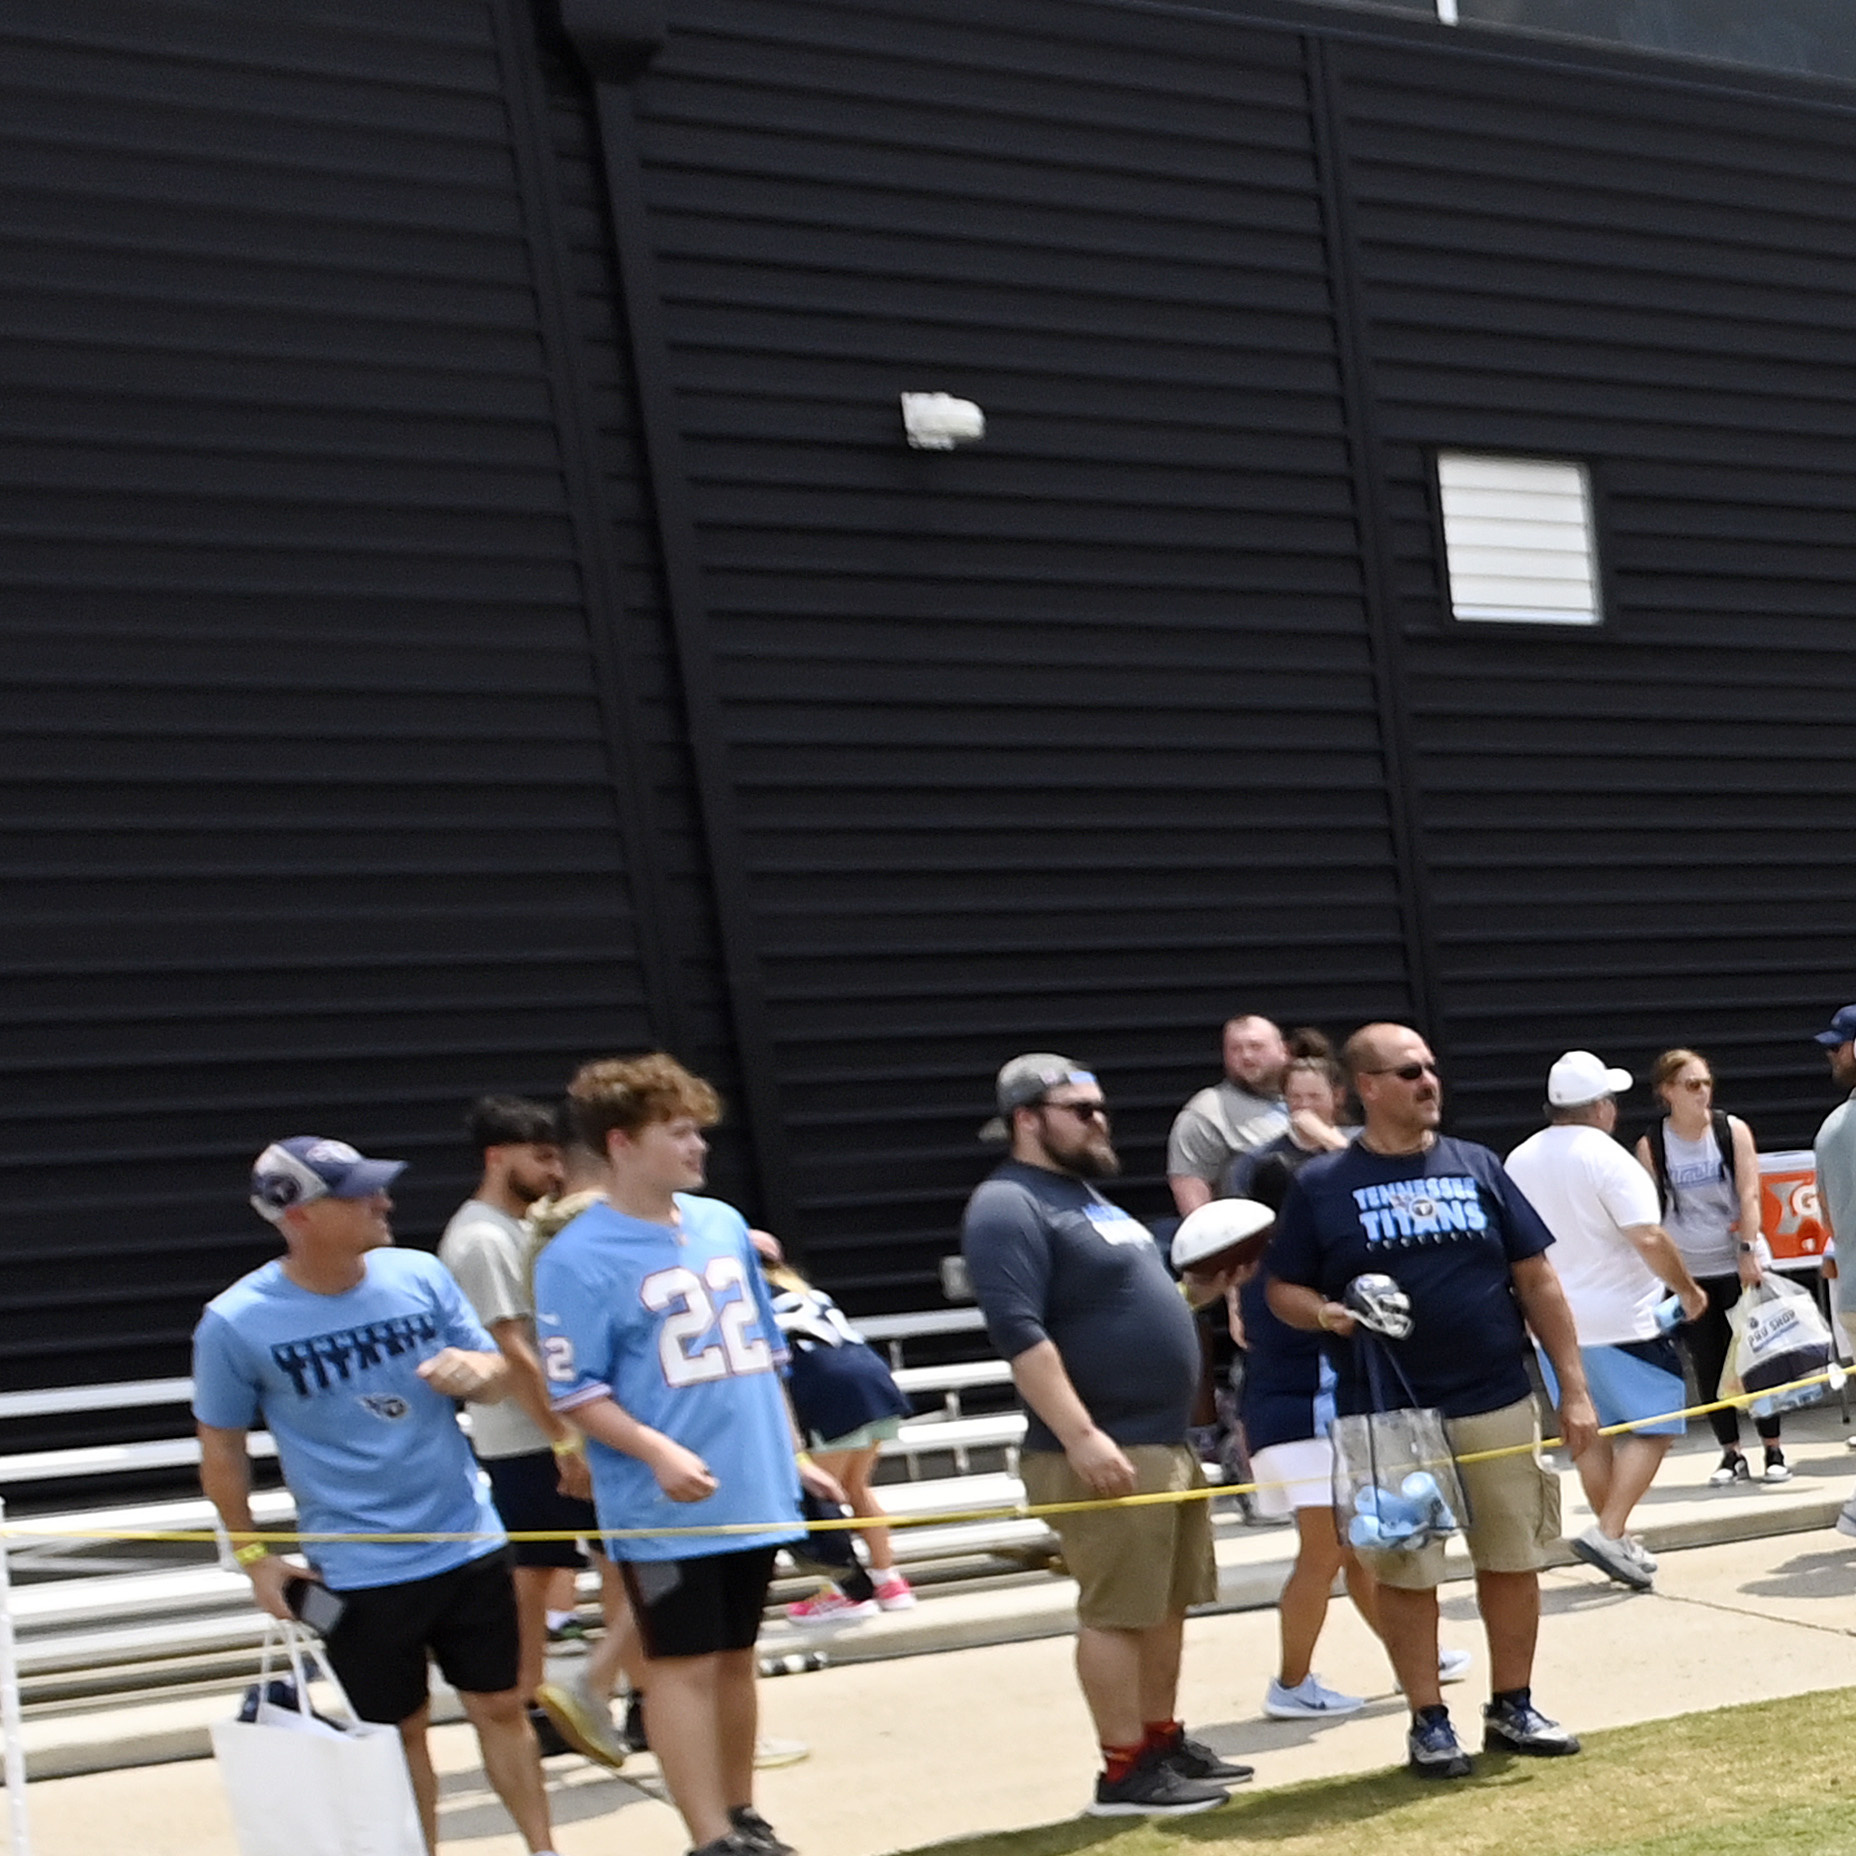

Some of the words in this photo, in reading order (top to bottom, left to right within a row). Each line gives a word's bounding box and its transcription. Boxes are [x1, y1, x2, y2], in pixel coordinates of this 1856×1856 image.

[1352, 1177, 1479, 1211] TENNESSEE
[1359, 1200, 1488, 1242] TITANS
[641, 1265, 774, 1389] 22
